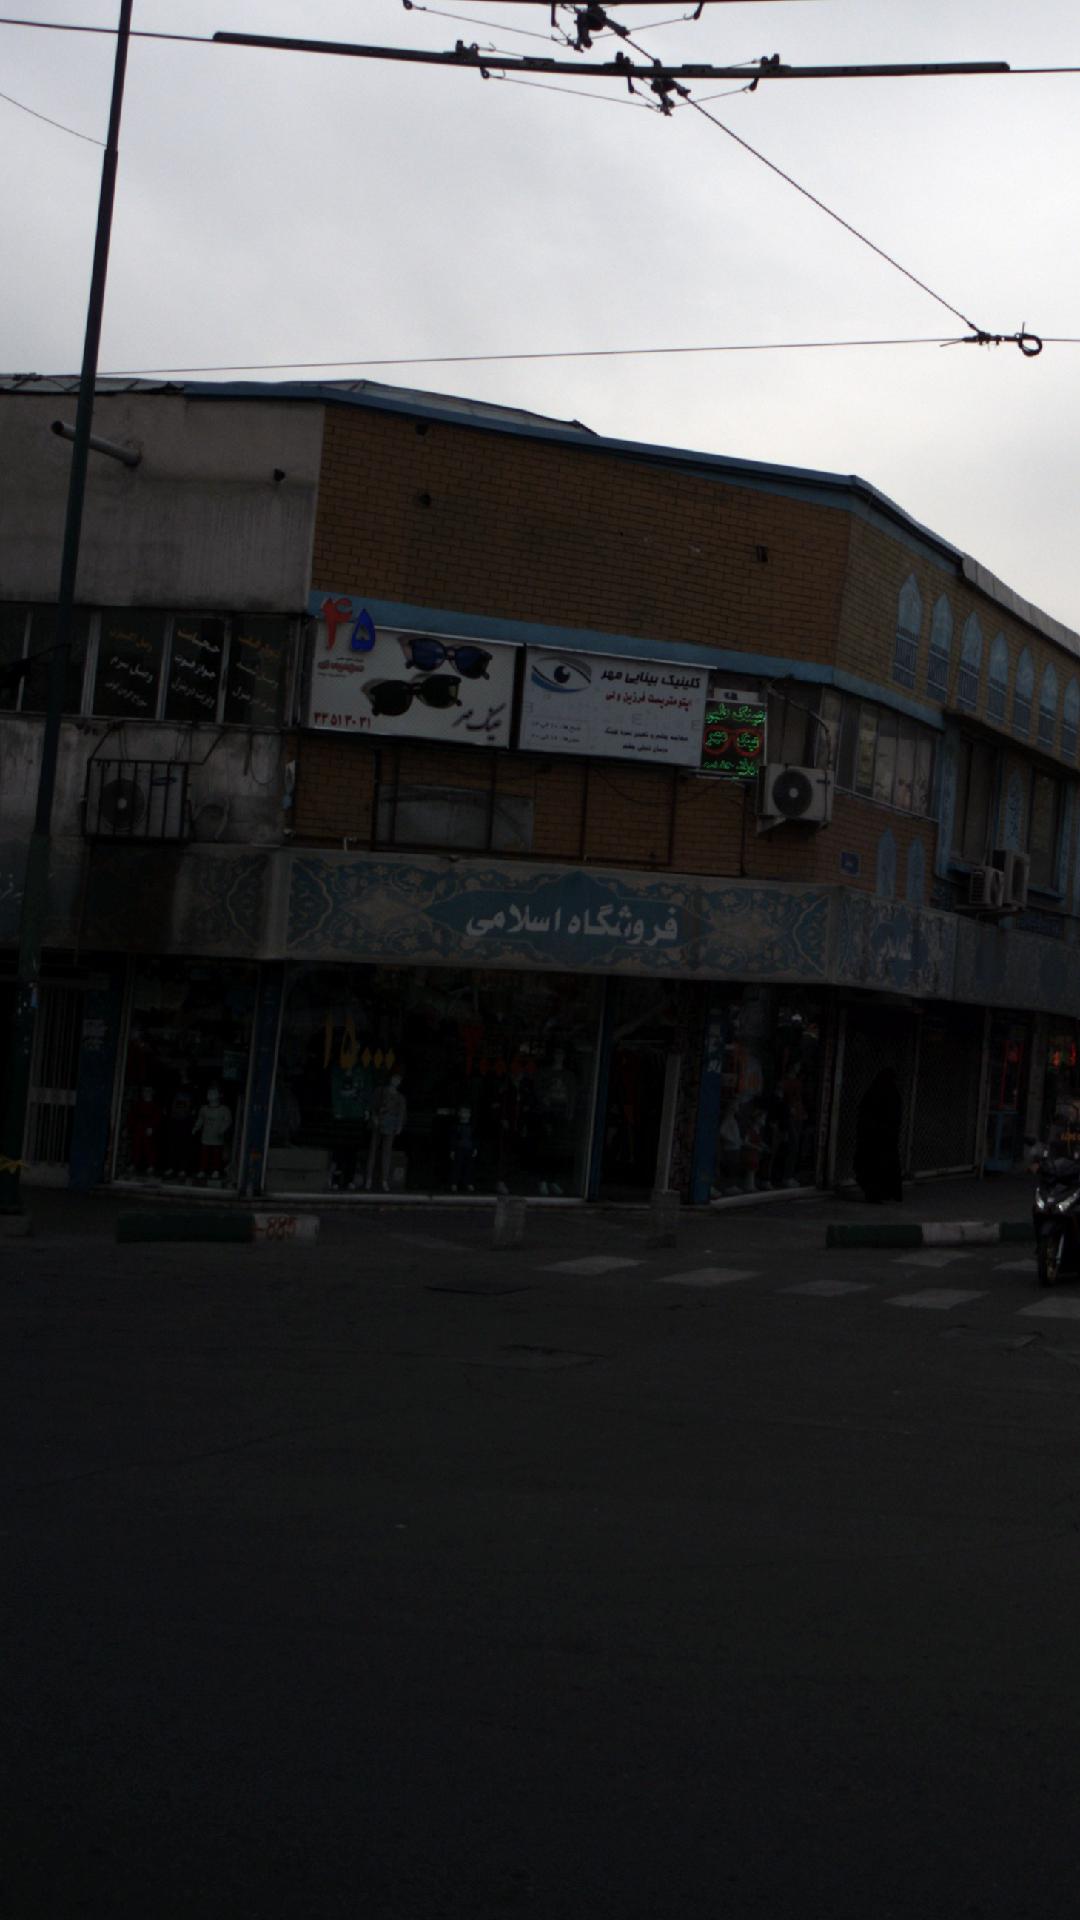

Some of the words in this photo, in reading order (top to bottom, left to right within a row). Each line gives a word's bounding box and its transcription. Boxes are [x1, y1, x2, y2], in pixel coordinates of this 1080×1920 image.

[600, 669, 623, 681] مهر
[625, 671, 658, 687] بینایی
[661, 674, 701, 690] کلینیک
[465, 903, 562, 938] اسلامی
[566, 903, 679, 947] فروشگاه
